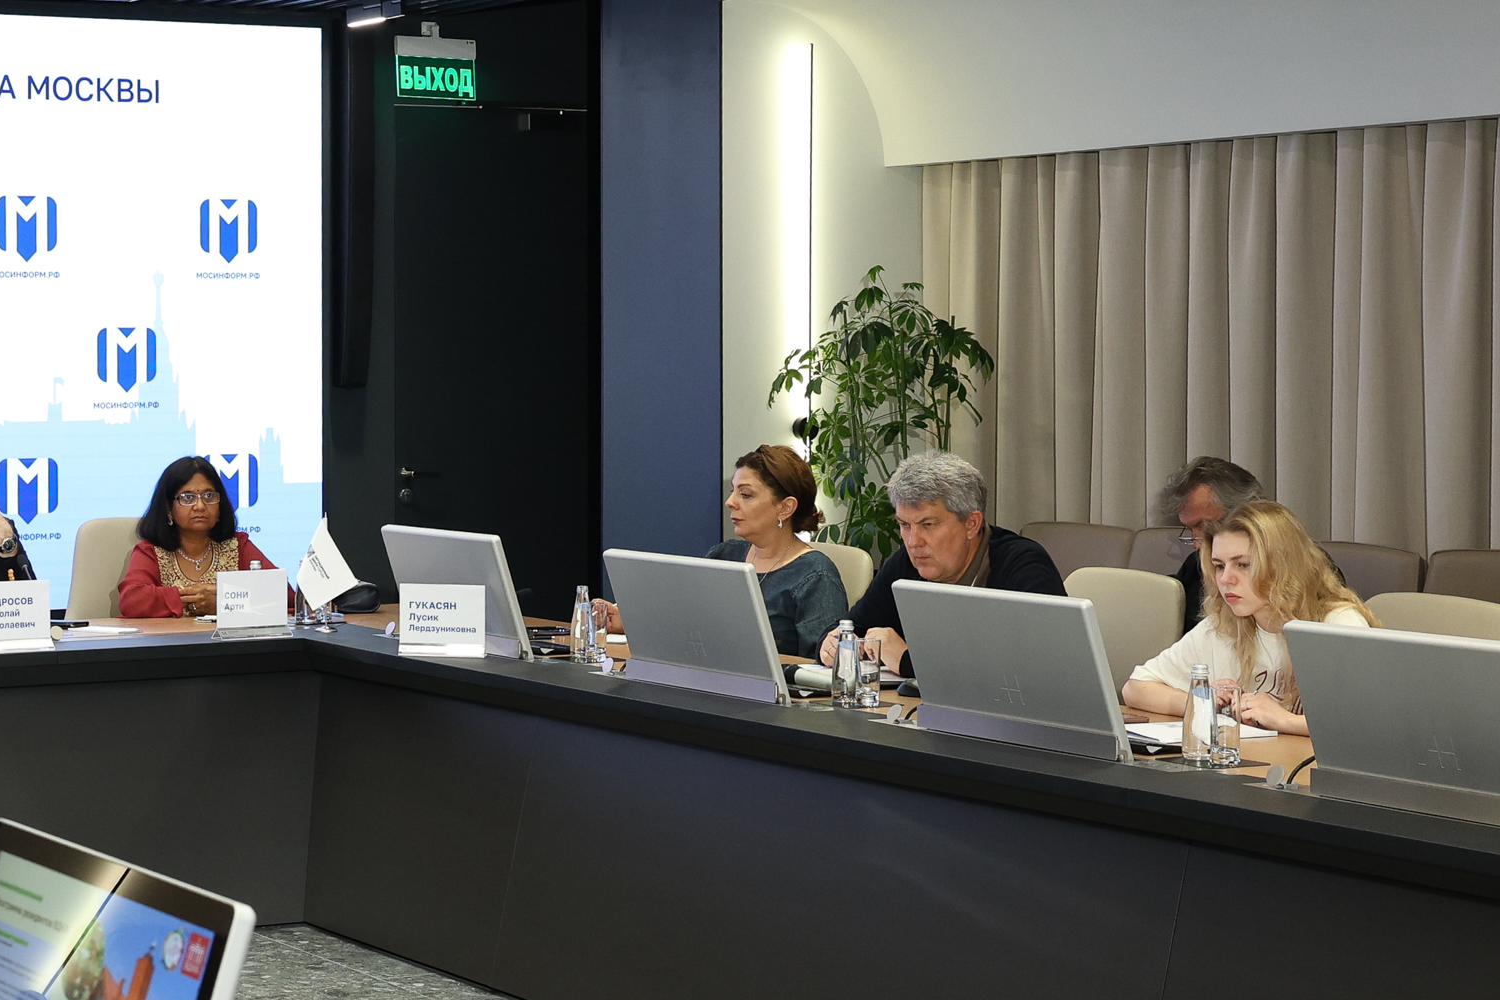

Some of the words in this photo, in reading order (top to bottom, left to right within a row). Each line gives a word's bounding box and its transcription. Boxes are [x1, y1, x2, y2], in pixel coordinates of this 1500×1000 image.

[400, 65, 474, 98] ВЫХОД
[28, 76, 159, 103] МОСКВЫ
[196, 272, 261, 280] МОСИНФОРМ.РФ
[93, 400, 160, 410] МОСИНФОРМ.РФ
[224, 591, 249, 600] СОНИ
[224, 603, 244, 612] Арти
[408, 601, 457, 610] ГУКАСЯН
[408, 612, 439, 622] Лусик
[408, 624, 477, 633] Лердзуниковна
